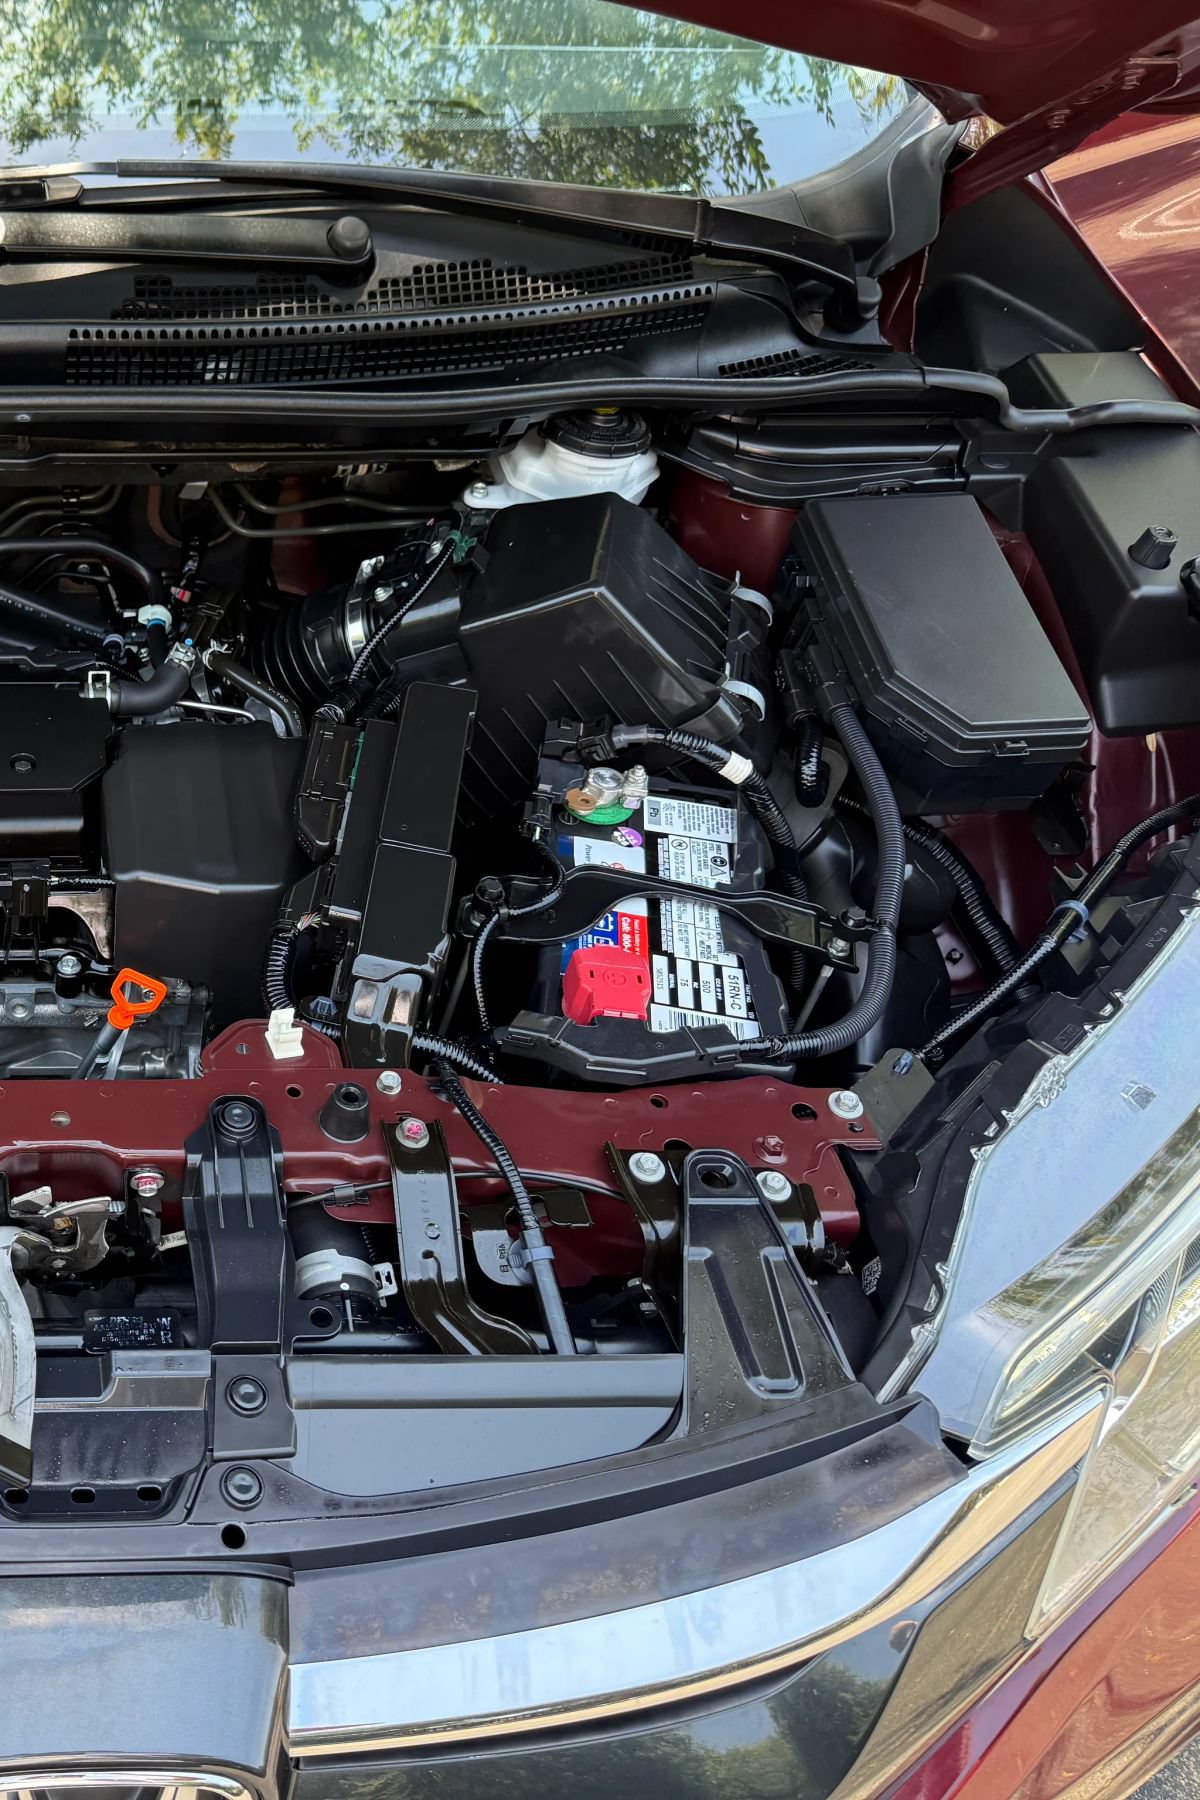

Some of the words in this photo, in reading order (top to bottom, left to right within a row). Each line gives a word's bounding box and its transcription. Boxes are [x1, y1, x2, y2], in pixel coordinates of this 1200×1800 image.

[585, 844, 593, 863] Power
[622, 917, 631, 933] Call:
[680, 979, 689, 987] 75
[702, 980, 711, 994] 500
[728, 974, 742, 1011] 51RN-C
